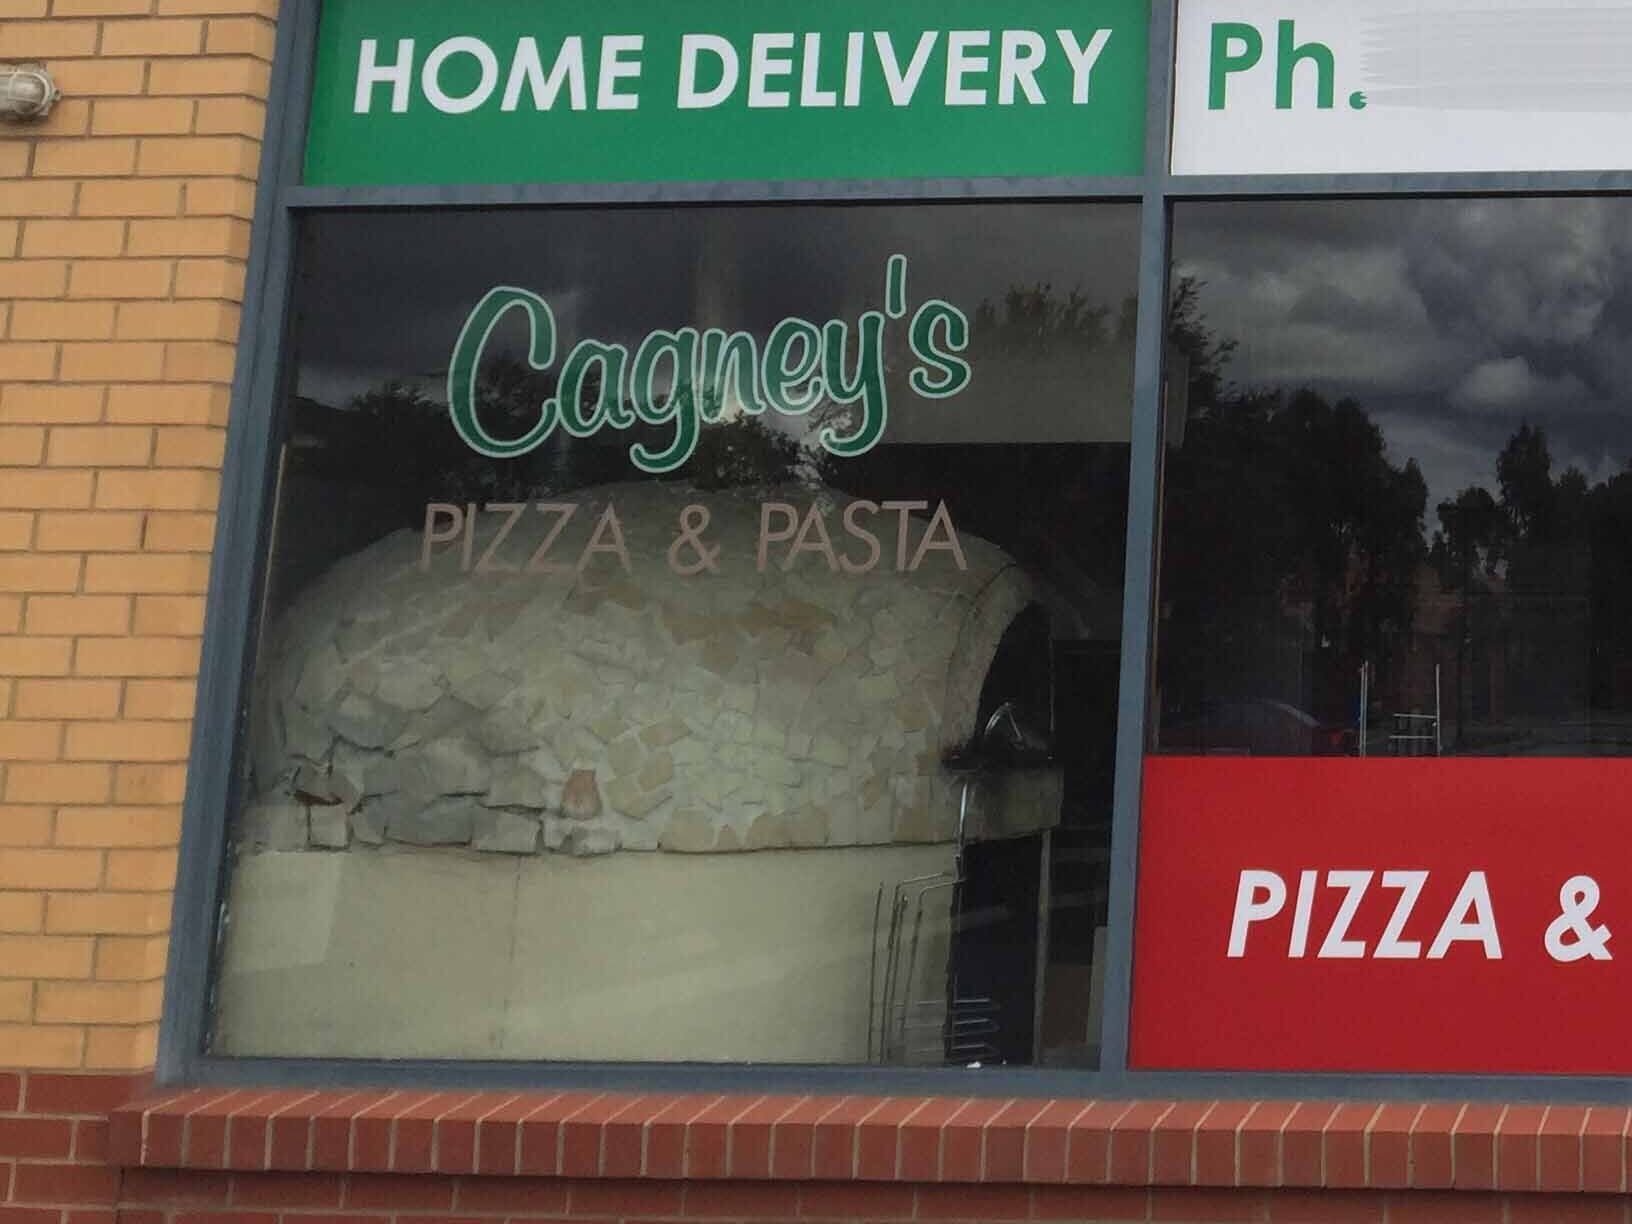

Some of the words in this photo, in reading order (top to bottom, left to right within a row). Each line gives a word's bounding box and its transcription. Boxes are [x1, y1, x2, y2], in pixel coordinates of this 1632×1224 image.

[353, 34, 643, 113] HOME
[677, 29, 1112, 110] DELIVERY
[1208, 19, 1367, 110] Ph.
[447, 253, 971, 472] Cagney's
[420, 502, 633, 574] PIZZA
[668, 504, 721, 574] &
[757, 498, 968, 574] PASTA
[1227, 870, 1503, 960] PIZZA
[1544, 875, 1613, 962] &
